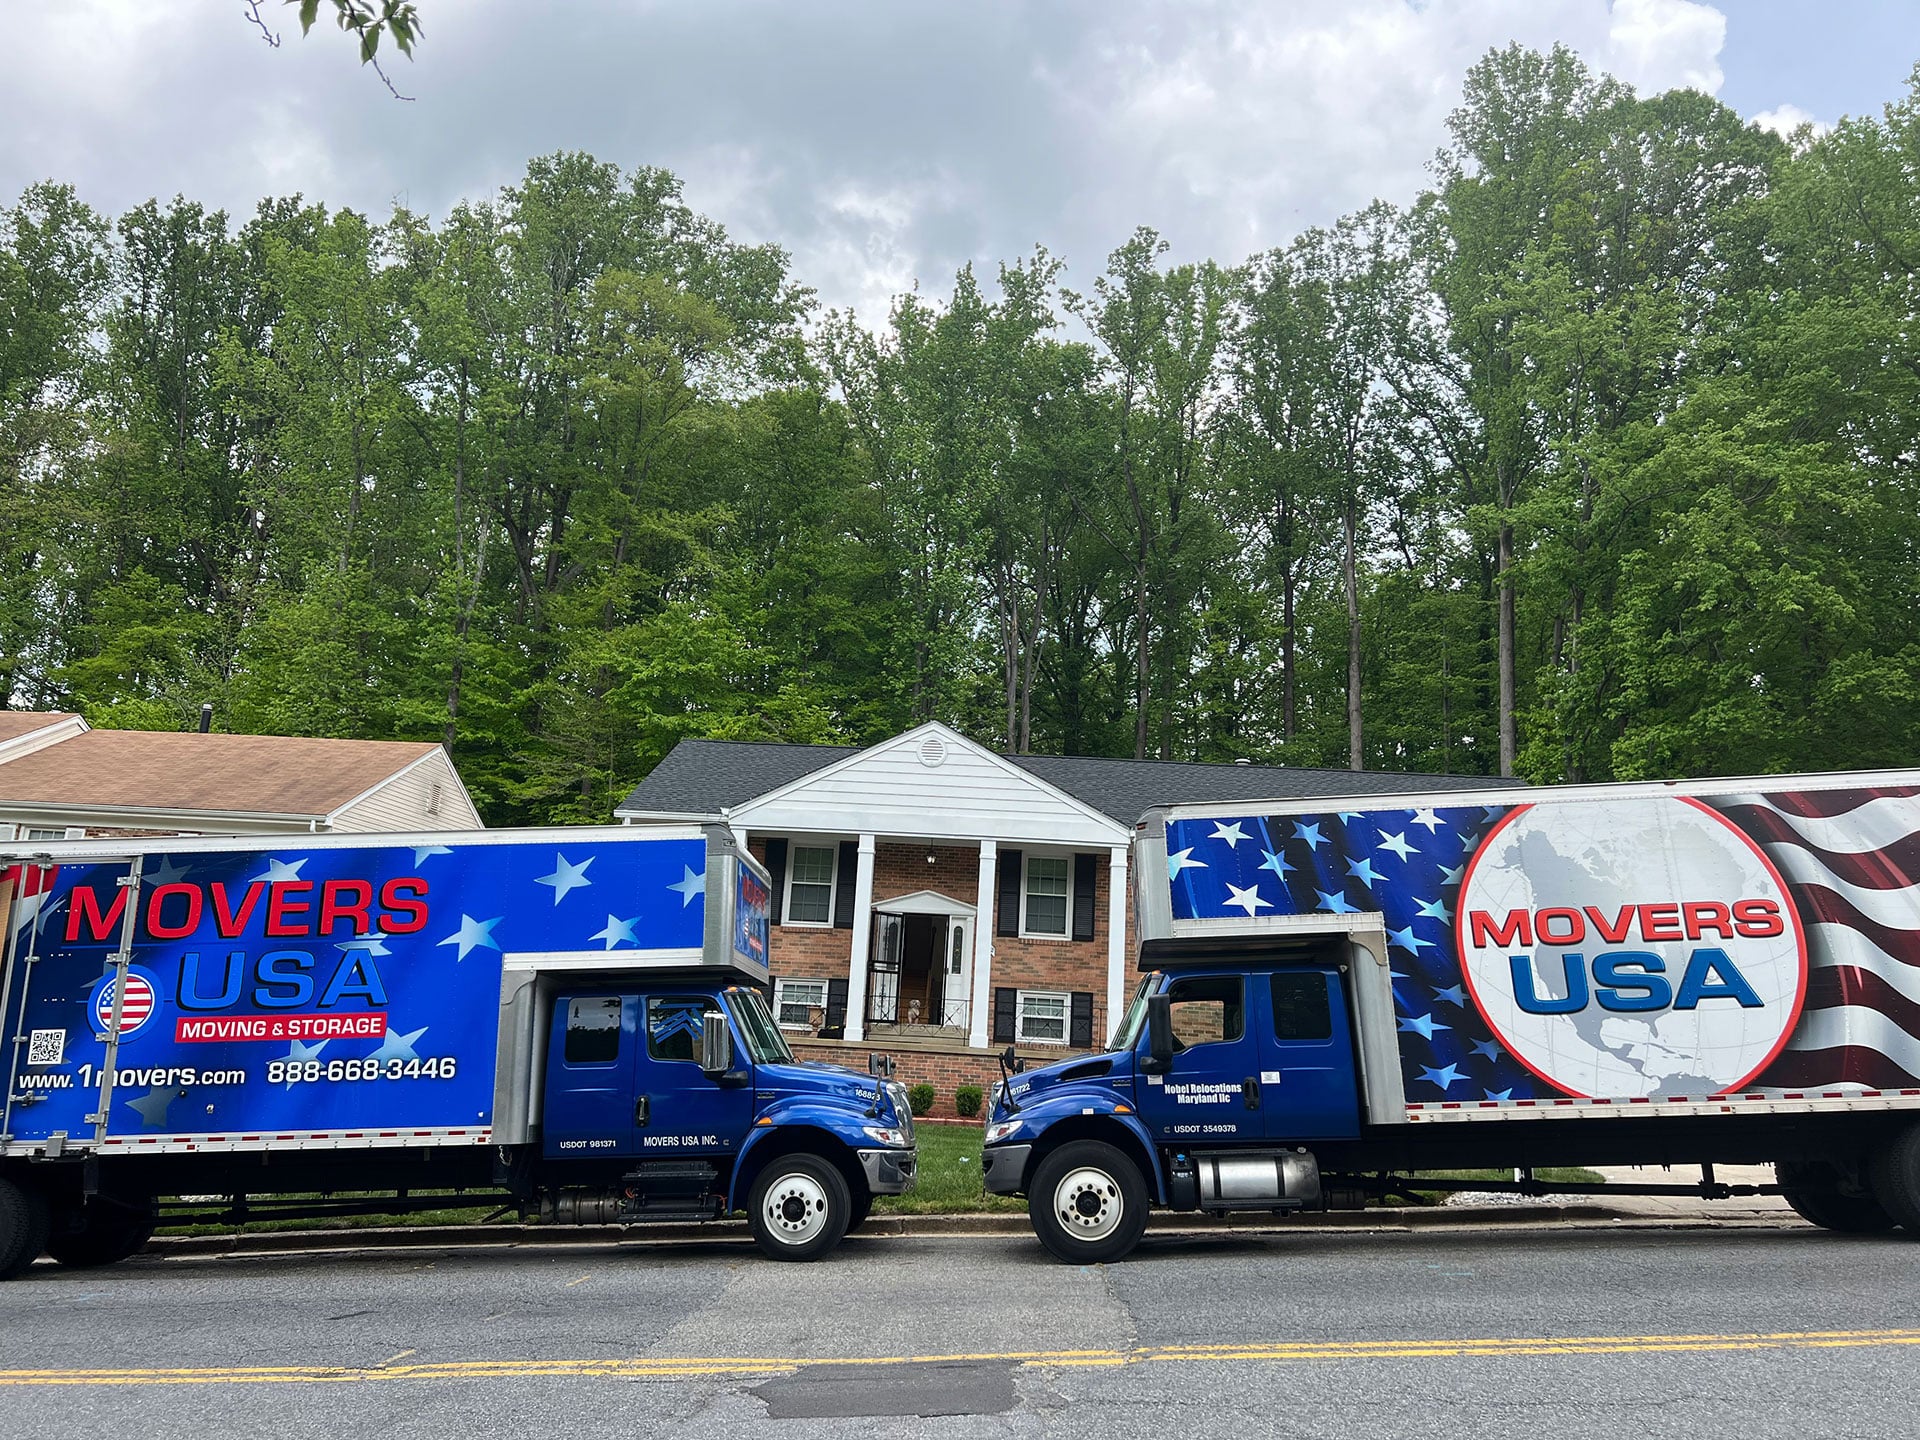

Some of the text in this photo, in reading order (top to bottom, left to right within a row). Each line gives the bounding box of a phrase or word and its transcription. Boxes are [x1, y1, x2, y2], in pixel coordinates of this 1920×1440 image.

[65, 877, 430, 941] MOVERS
[1469, 899, 1785, 948] MOVERS
[178, 948, 390, 1010] USA
[1508, 947, 1765, 1016] USA
[182, 1016, 382, 1039] MOVING & STORAGE
[267, 1057, 456, 1083] 888-668-3446
[1164, 1083, 1242, 1094] Nobel Relocations
[1177, 1094, 1218, 1105] Maryland
[560, 1140, 616, 1149] USDOT 981371
[643, 1135, 719, 1147] MOVERS USA INC.
